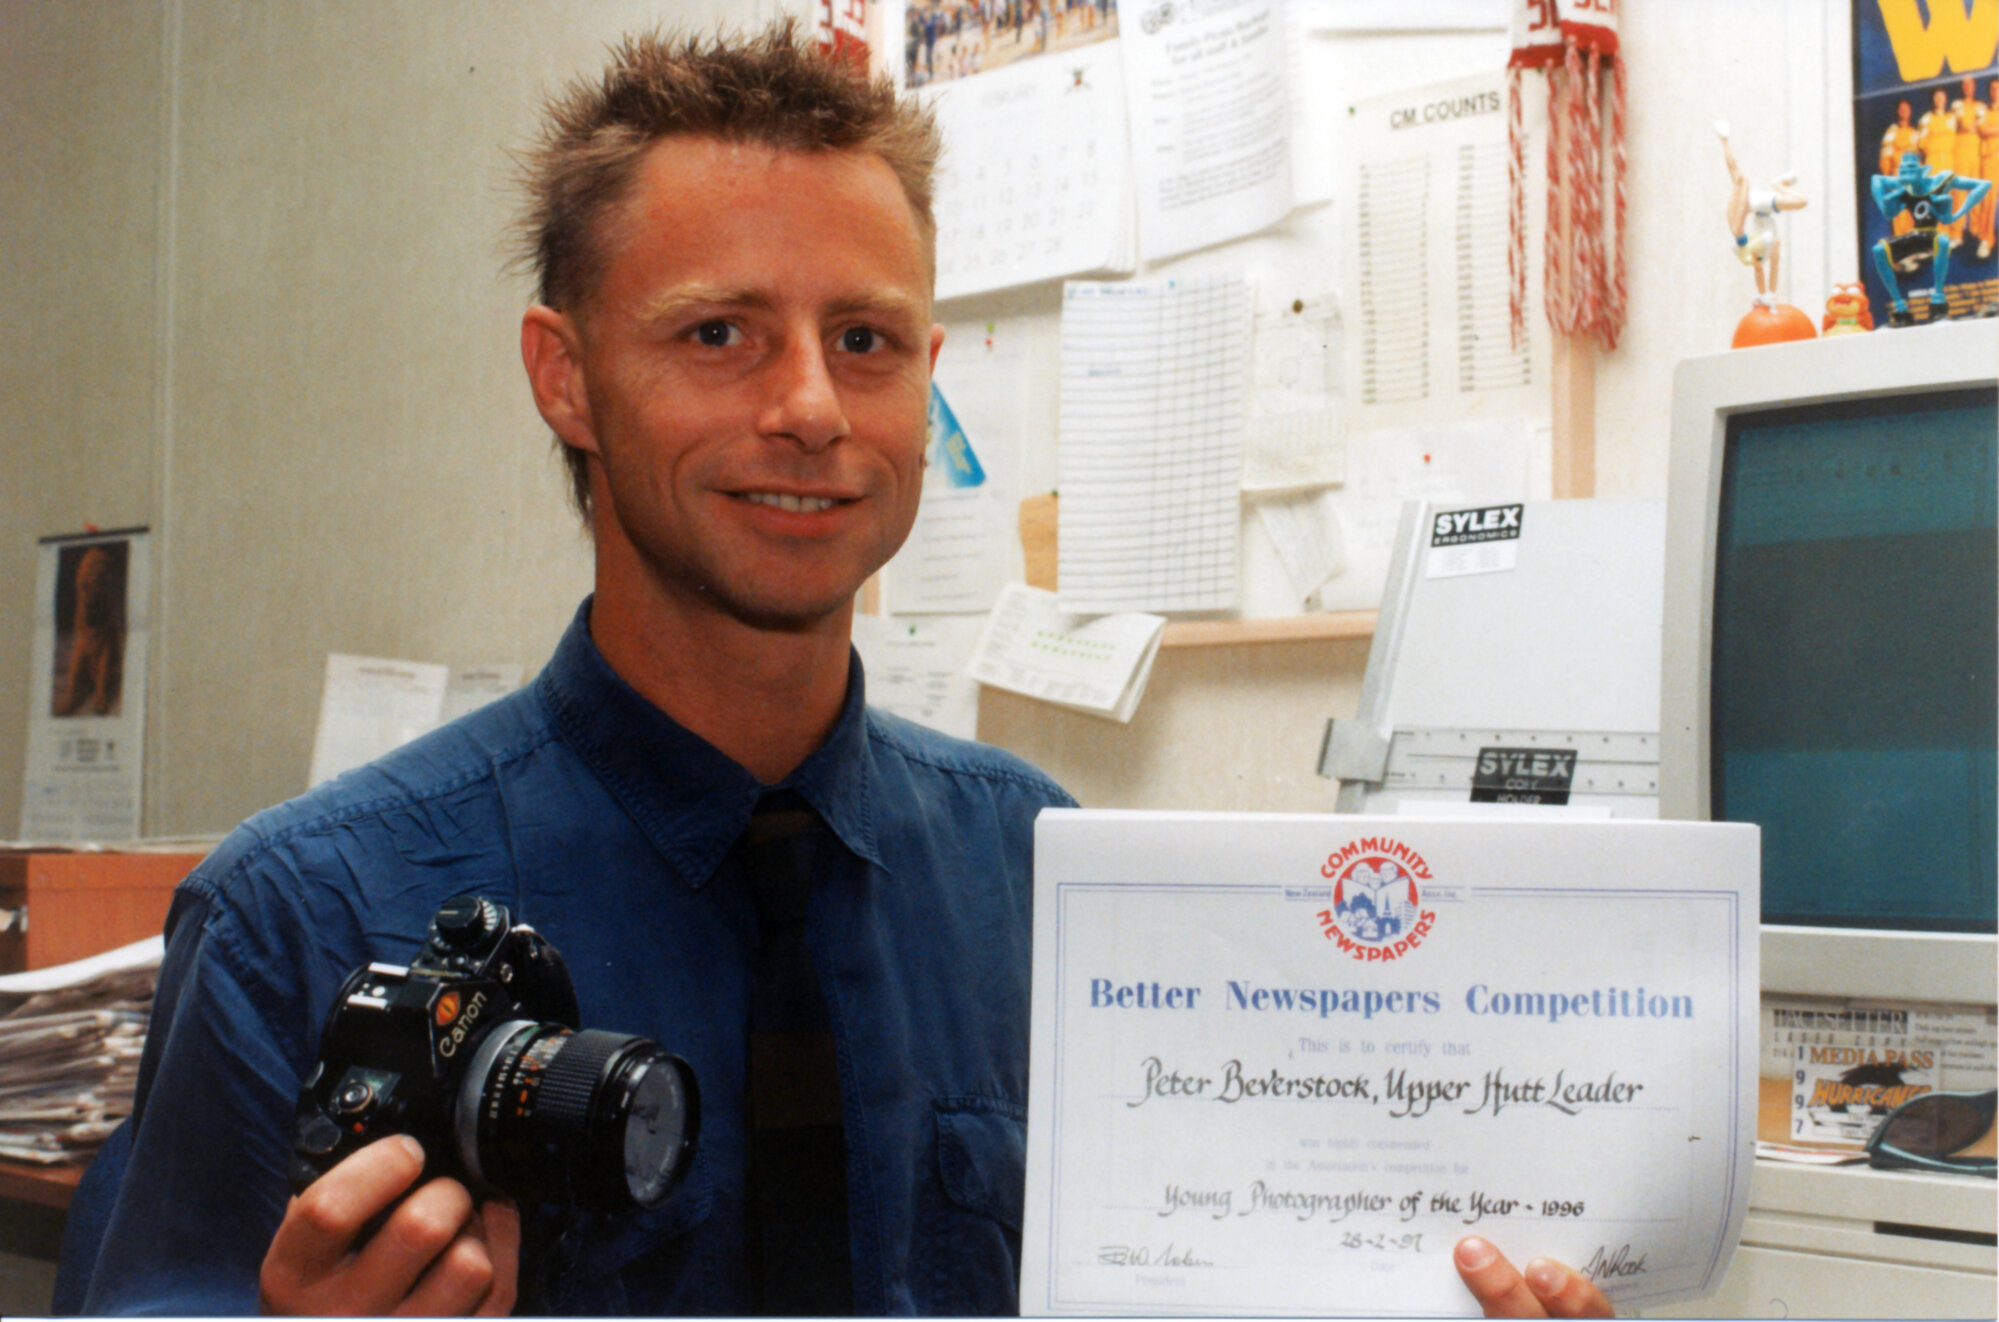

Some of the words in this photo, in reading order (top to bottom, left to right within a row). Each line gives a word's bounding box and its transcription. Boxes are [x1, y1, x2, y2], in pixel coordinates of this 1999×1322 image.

[1390, 108, 1416, 128] CM
[1423, 91, 1501, 122] COUNTS
[1433, 529, 1517, 546] ERGONOMICS
[1435, 506, 1520, 535] SYLEX
[1480, 752, 1572, 778] SYLEX
[1320, 836, 1434, 879] COMMUNITY
[1316, 909, 1436, 963] NEWSPAPERS
[1090, 978, 1201, 1009] Better
[1225, 981, 1441, 1020] Newspapers
[1465, 984, 1694, 1022] Competition
[439, 990, 487, 1058] Canon
[1298, 1036, 1329, 1053] This
[1339, 1038, 1350, 1053] is
[1361, 1040, 1376, 1053] to
[1385, 1039, 1432, 1058] certify
[1442, 1040, 1471, 1056] that
[1810, 1046, 1878, 1065] MEDIA
[1885, 1049, 1935, 1070] PASS
[1126, 1056, 1212, 1108] Peter
[1212, 1059, 1380, 1105] Beverstock,
[1384, 1066, 1471, 1118] Upper
[1462, 1065, 1546, 1117] Hutt
[1545, 1068, 1644, 1116] Leader
[1806, 1079, 1932, 1111] HURRICAN
[1157, 1183, 1233, 1221] Young
[1237, 1179, 1393, 1224] Photographer
[1399, 1190, 1423, 1222] of
[1430, 1188, 1464, 1214] the
[1462, 1190, 1519, 1224] Year
[1541, 1200, 1585, 1217] 1996
